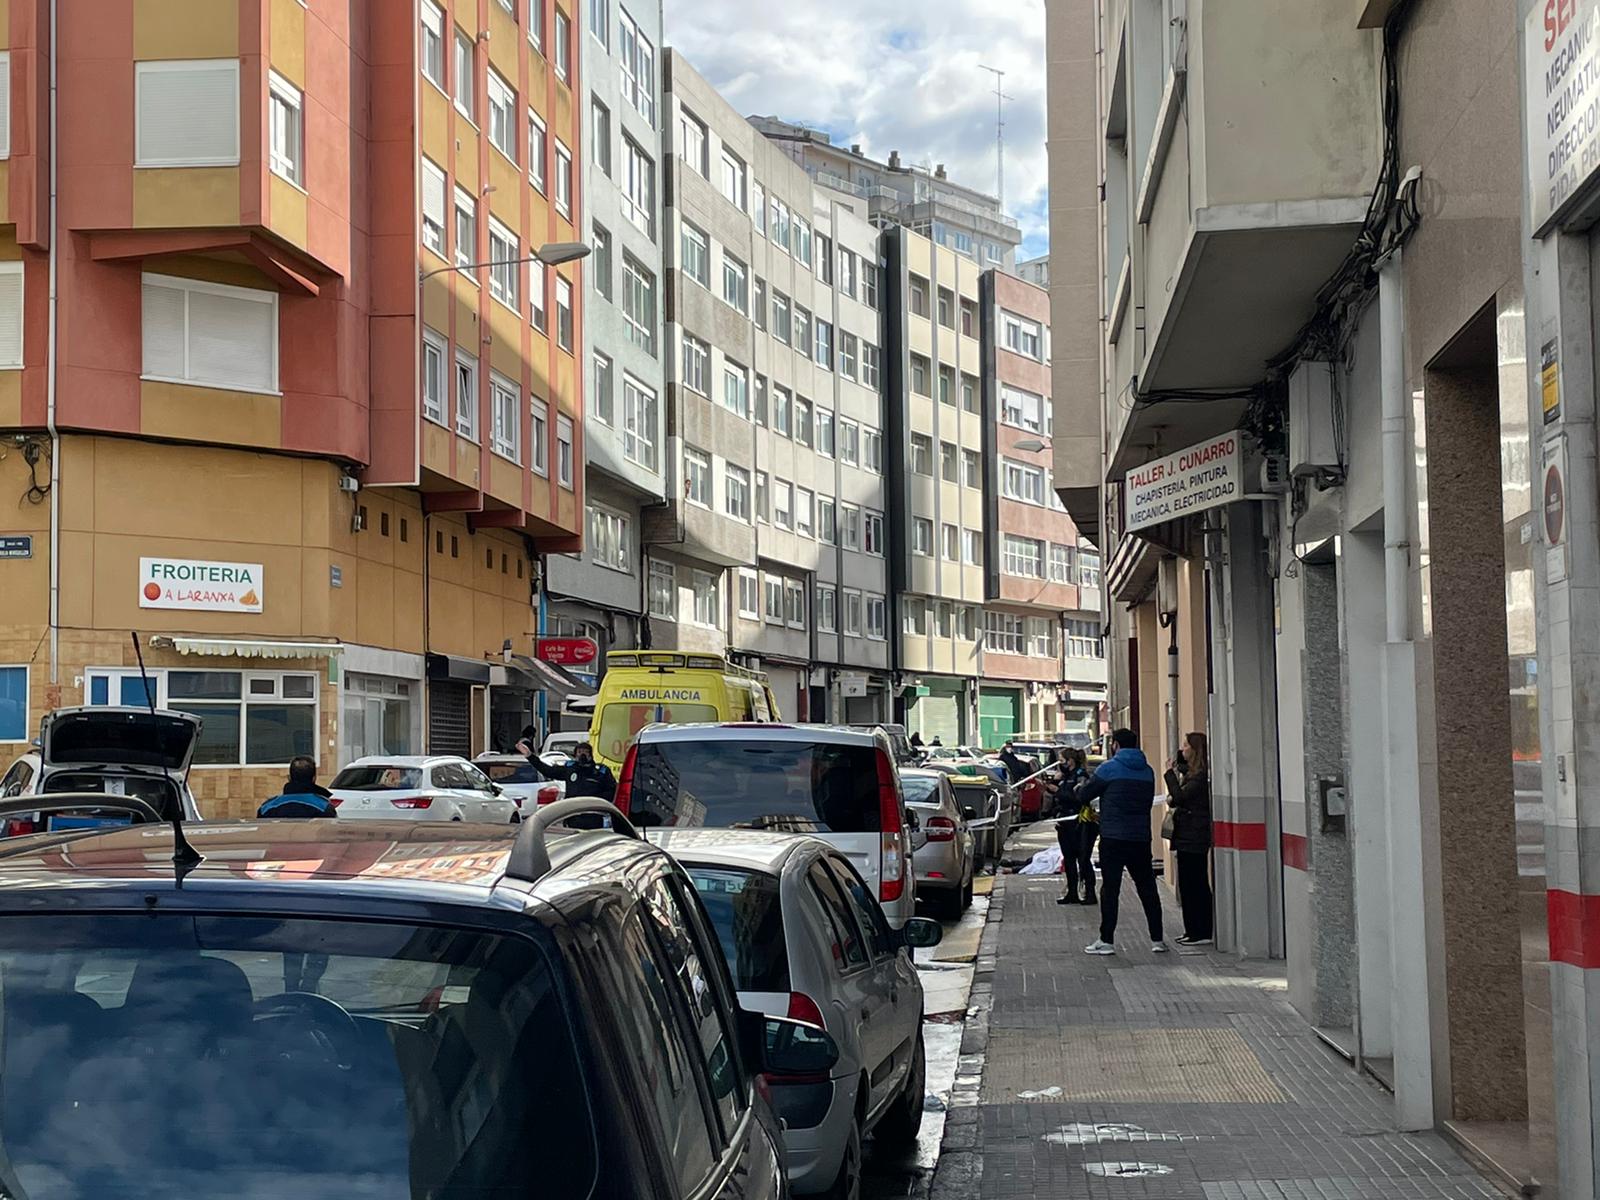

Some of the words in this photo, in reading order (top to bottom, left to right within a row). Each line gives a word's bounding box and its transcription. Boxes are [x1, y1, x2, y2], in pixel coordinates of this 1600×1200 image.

[1128, 464, 1165, 491] TALLER
[1167, 460, 1176, 477] J.
[1190, 464, 1229, 489] PINTURA
[1173, 481, 1235, 512] ELECTRICIDAD
[151, 563, 253, 584] FROITERIA
[165, 589, 173, 601] A
[177, 589, 235, 603] LARANXA
[620, 688, 701, 701] AMBULANCIA
